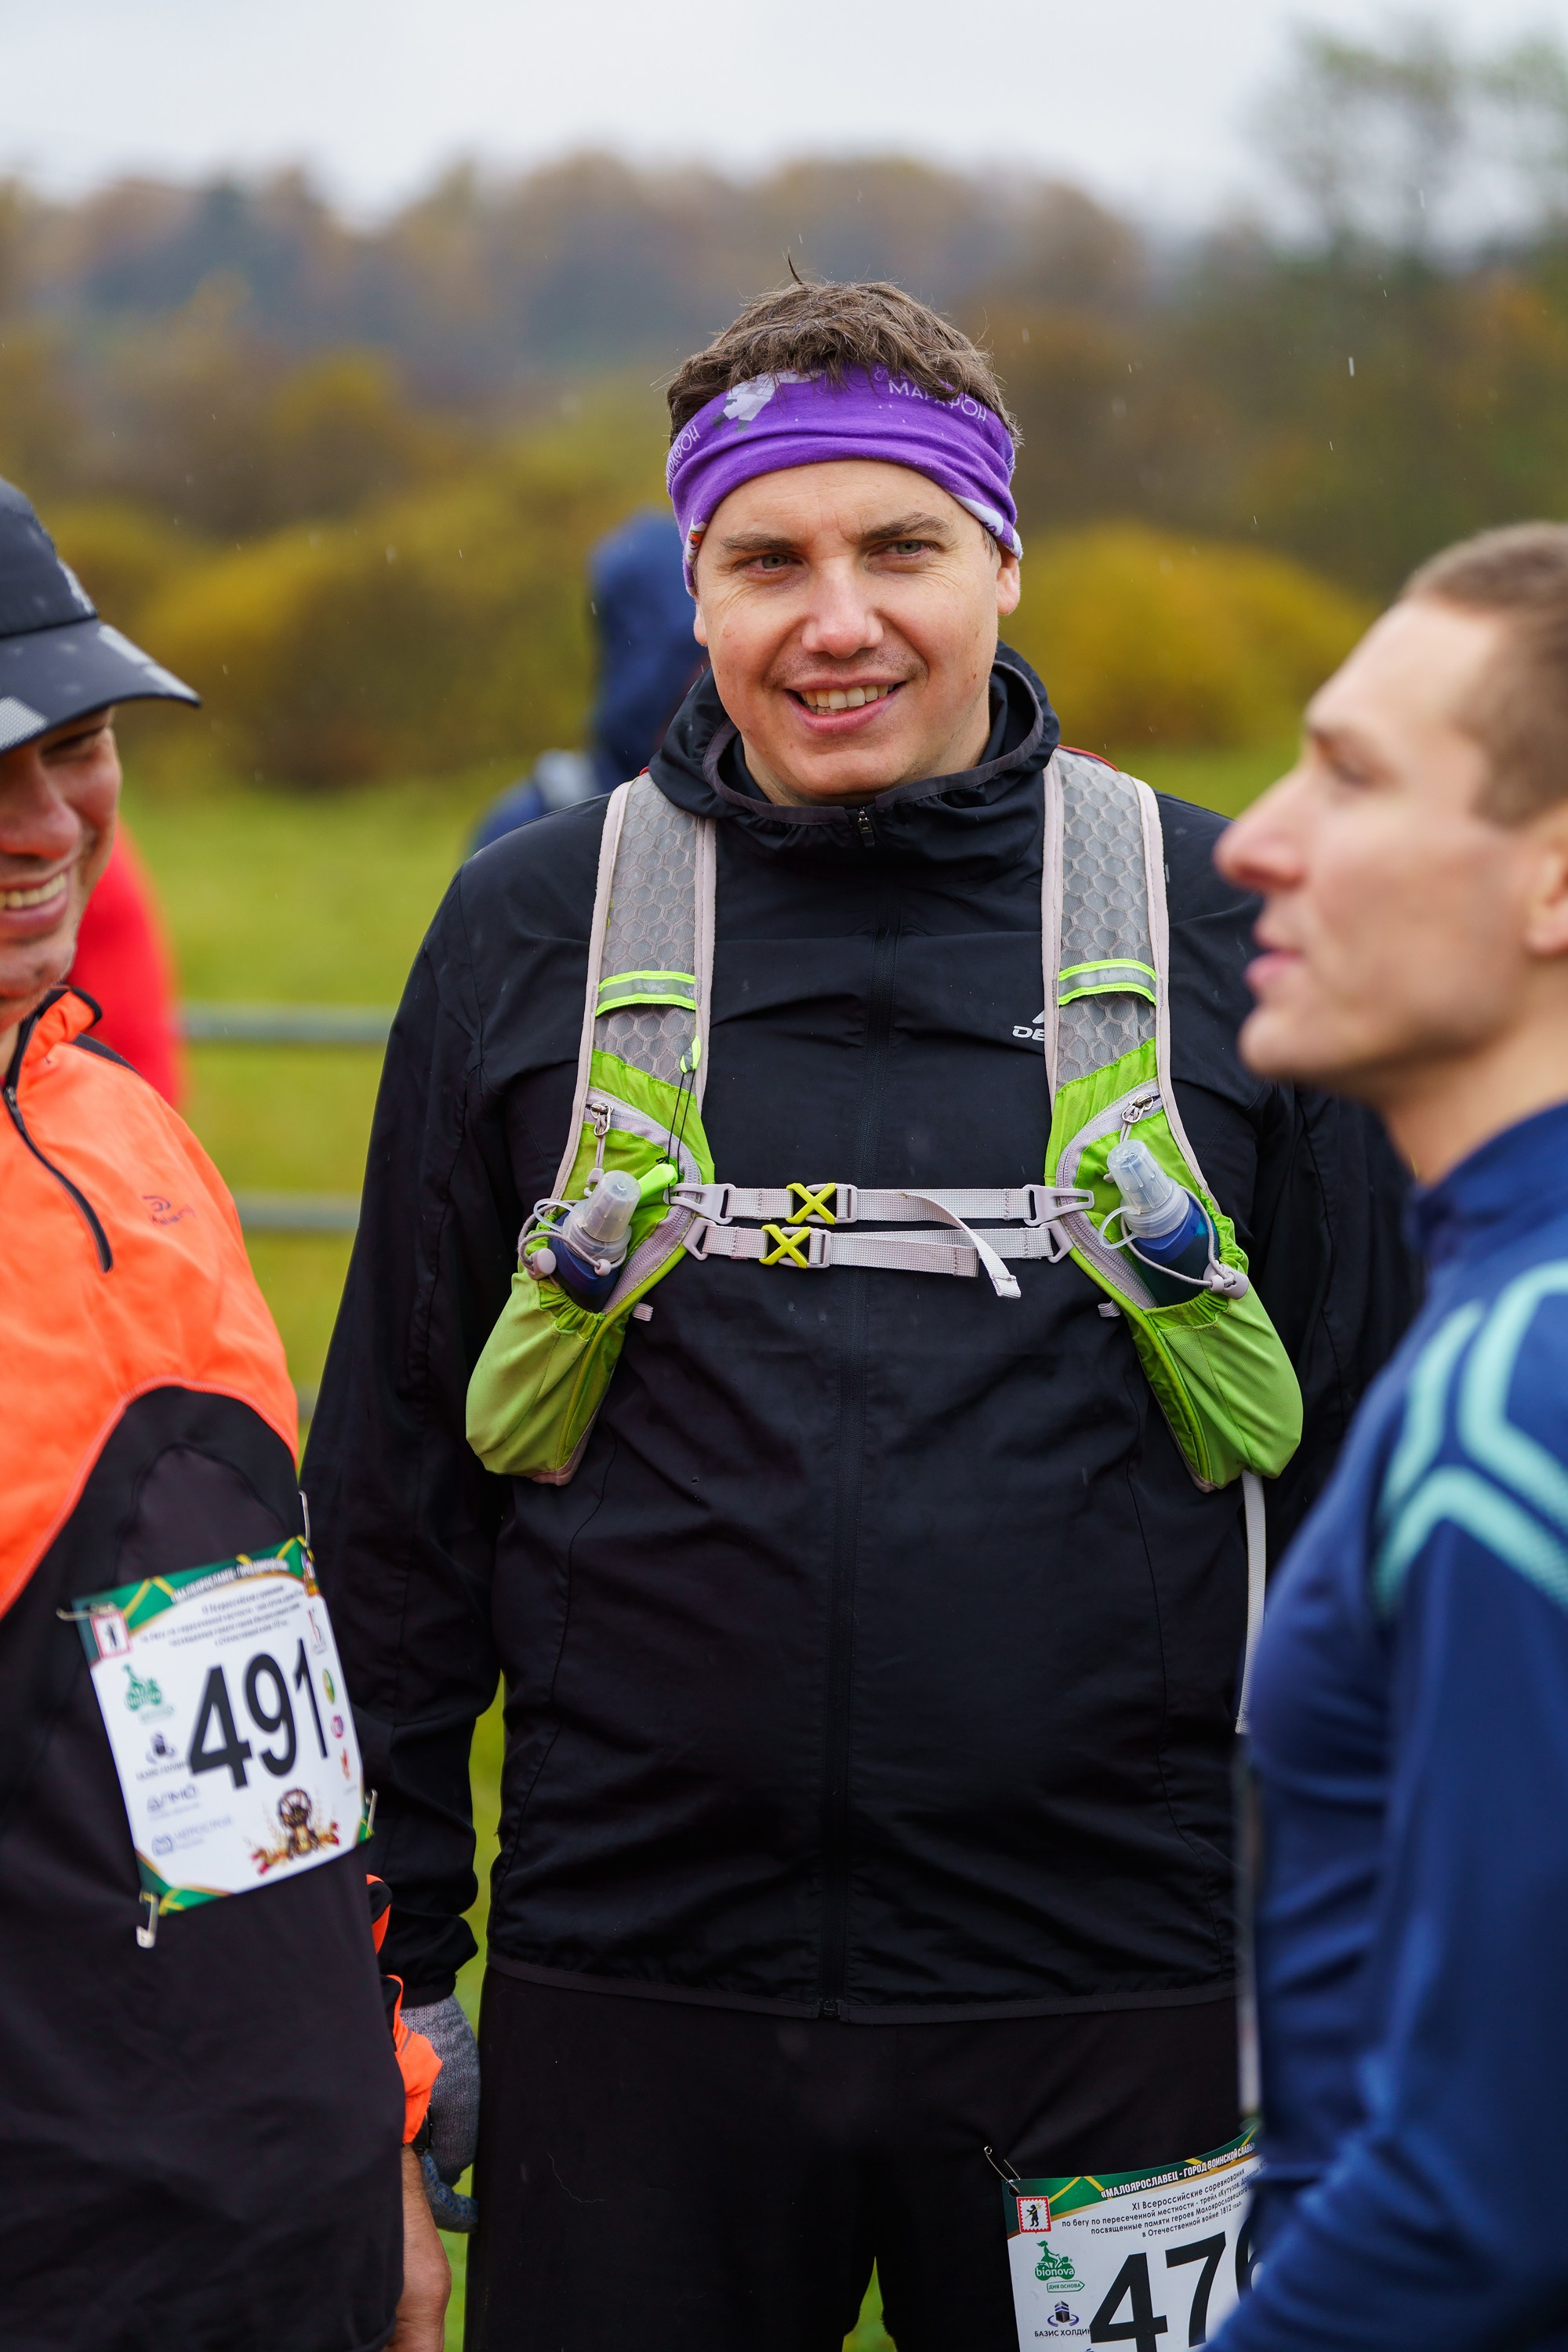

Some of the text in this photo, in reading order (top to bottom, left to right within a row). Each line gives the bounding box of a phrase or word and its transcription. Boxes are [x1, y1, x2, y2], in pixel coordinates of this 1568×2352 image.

[187, 1636, 328, 1790] 491
[1183, 2161, 1207, 2177] ГОРОД
[1207, 2148, 1238, 2169] ВОИНСКОЙ
[1142, 2188, 1203, 2209] Всероссийские
[1204, 2169, 1245, 2193] соревнования
[1091, 2223, 1142, 2234] посвященные
[1144, 2218, 1170, 2228] памяти
[1171, 2210, 1194, 2223] героев
[1196, 2187, 1248, 2216] Малоярославецкого
[1102, 2210, 1156, 2224] пересеченной
[1157, 2201, 1194, 2216] местности
[1200, 2191, 1218, 2206] трейл
[1148, 2217, 1200, 2237] Отечественной
[1202, 2211, 1219, 2223] войне
[1220, 2204, 1232, 2215] 1812
[1036, 2267, 1074, 2277] bionova
